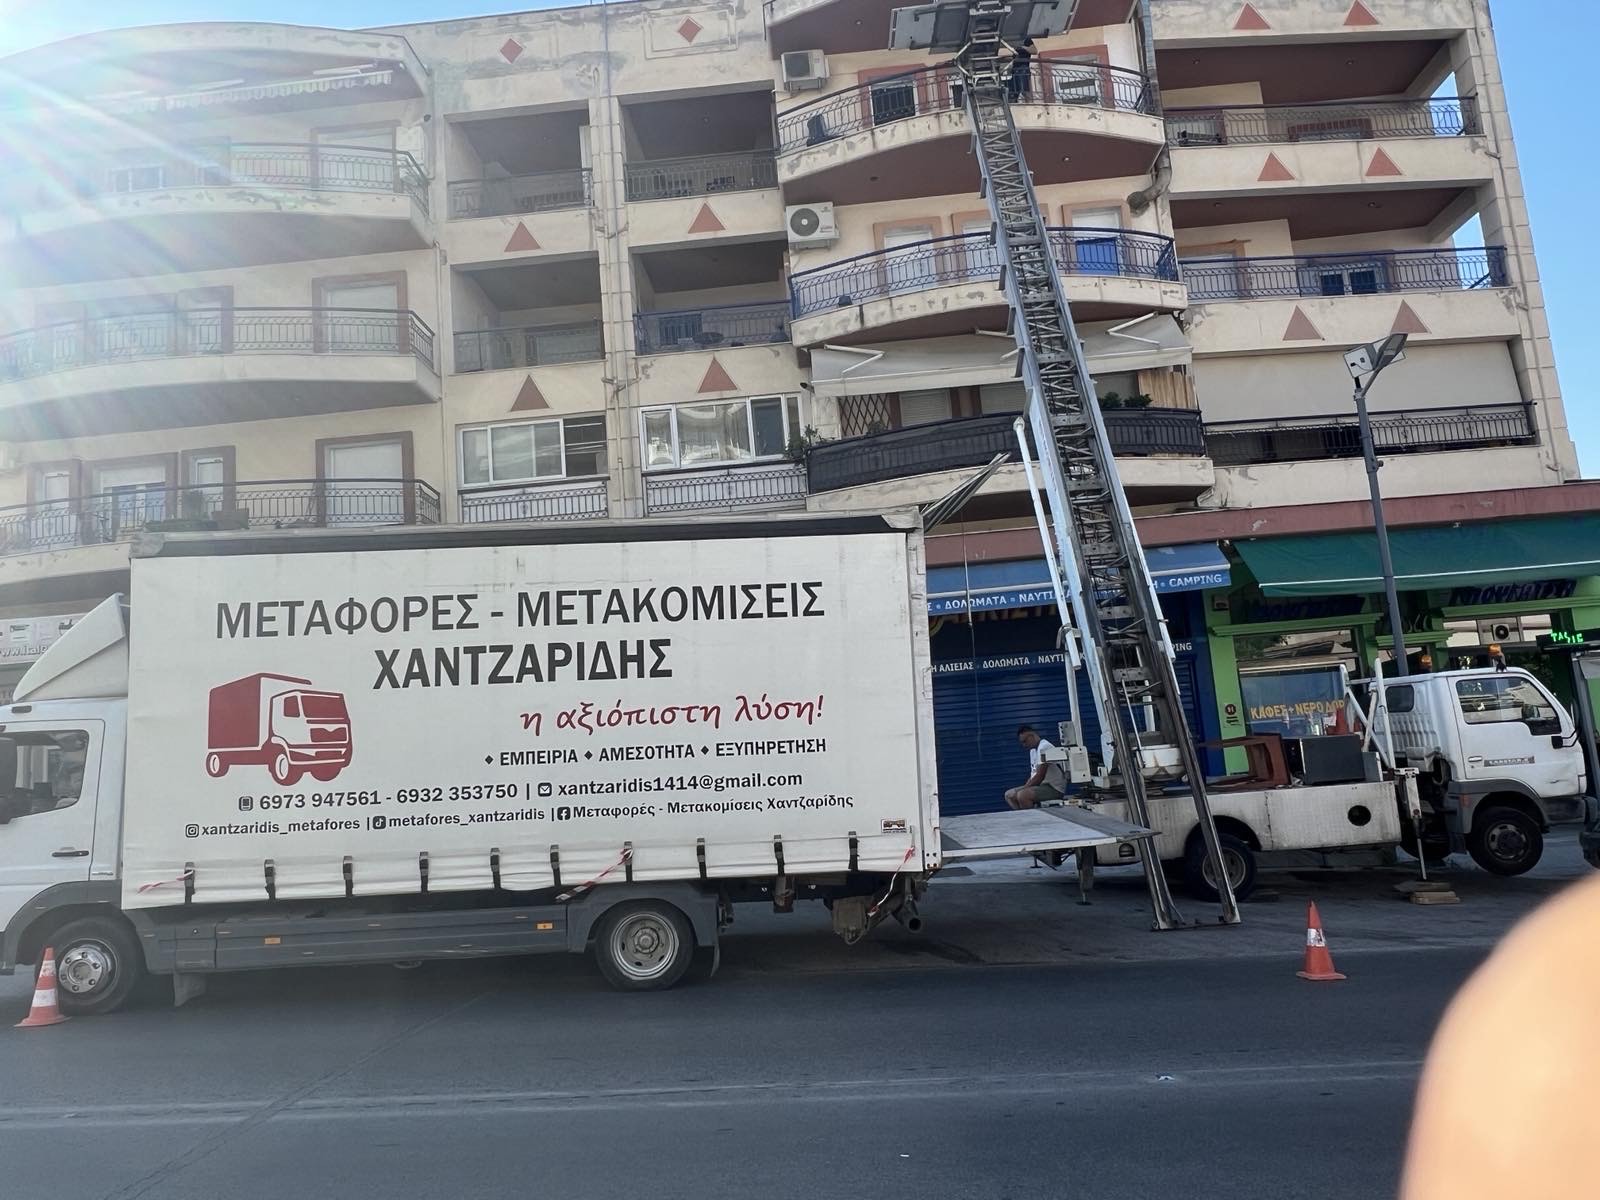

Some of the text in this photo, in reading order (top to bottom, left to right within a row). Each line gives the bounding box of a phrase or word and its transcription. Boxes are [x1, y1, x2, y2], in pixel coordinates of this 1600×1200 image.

[216, 593, 480, 639] ΜΕΤΑΦΟΡΕΣ
[517, 581, 825, 627] ΜΕΤΑΚΟΜΙΣΕΙΣ
[944, 595, 1007, 610] ΔΟΛΩΜΑΤΑ
[1169, 574, 1222, 588] CAMPING
[372, 638, 673, 690] ΧΑΝΤΖΑΡΙΔΗΣ
[939, 661, 974, 673] ΑΛΙΕΙΑΣ
[982, 656, 1030, 669] ΔΟΛΩΜΑΤΑ
[520, 693, 824, 736] η αξιόπιστη λύση!
[500, 738, 827, 766] ΕΜΠΕΙΡΙΑ ΑΜΕΣΟΤΗΤΑ ΕΞΥΠΗΡΕΤΗΣΗ
[259, 793, 306, 810] 6973
[311, 790, 382, 808] 947561
[396, 787, 443, 804] 6932
[448, 783, 518, 801] 353750
[558, 772, 803, 796] xantzaridis1414@gmail.com
[201, 817, 360, 836] xantzaridis_metafores
[388, 808, 545, 827] metafores_xantzaridis
[573, 802, 655, 819] Μεταφορές
[667, 798, 763, 814] Μετακομίσεις
[766, 794, 854, 810] Χαντζαρίδης
